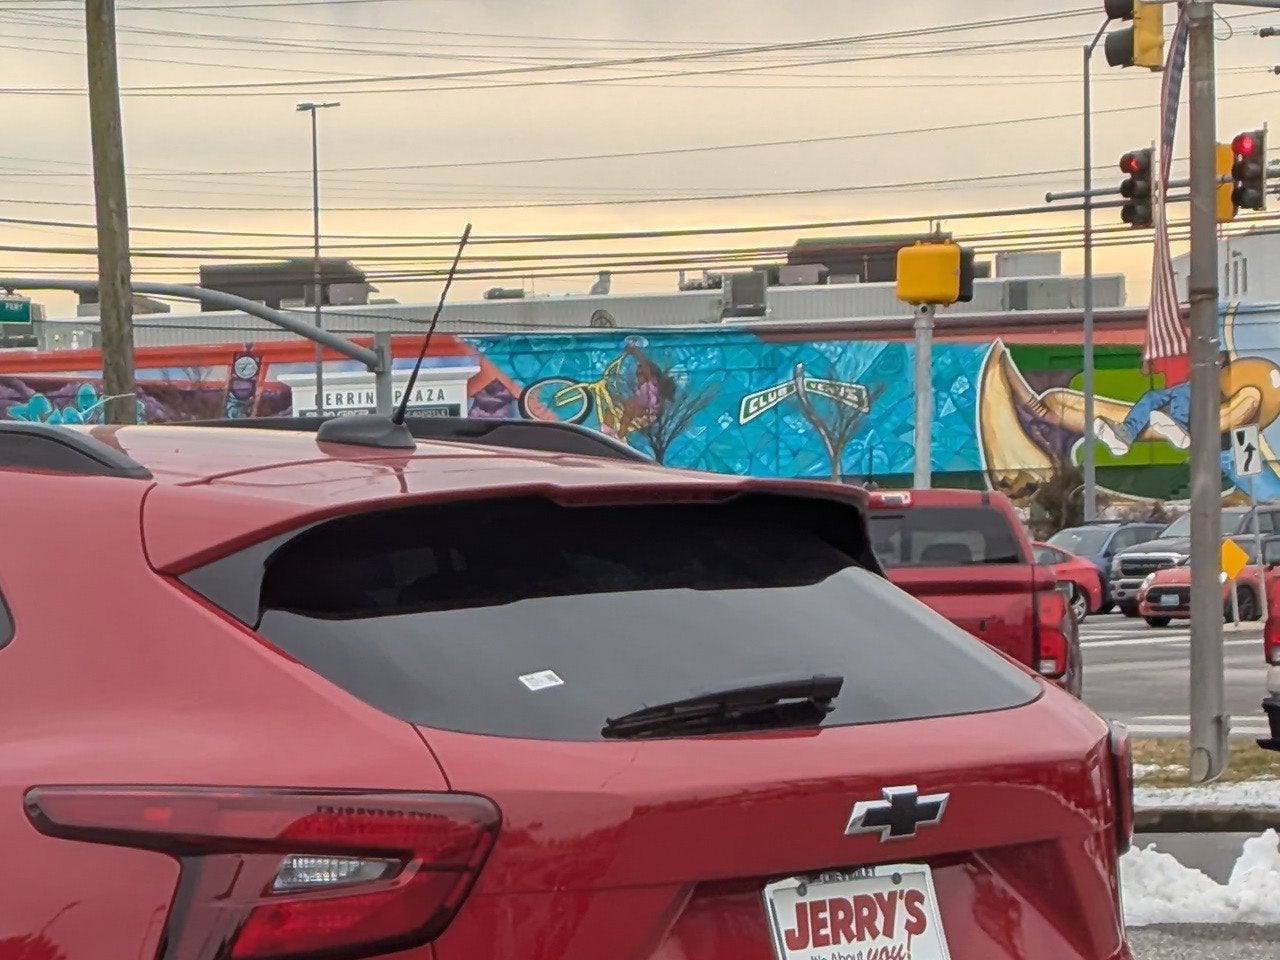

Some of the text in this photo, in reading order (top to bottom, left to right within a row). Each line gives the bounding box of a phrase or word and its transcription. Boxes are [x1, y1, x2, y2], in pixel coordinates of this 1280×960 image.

[315, 392, 375, 406] ERRIN
[748, 386, 788, 413] CLUB
[784, 888, 927, 951] JERRY'S
